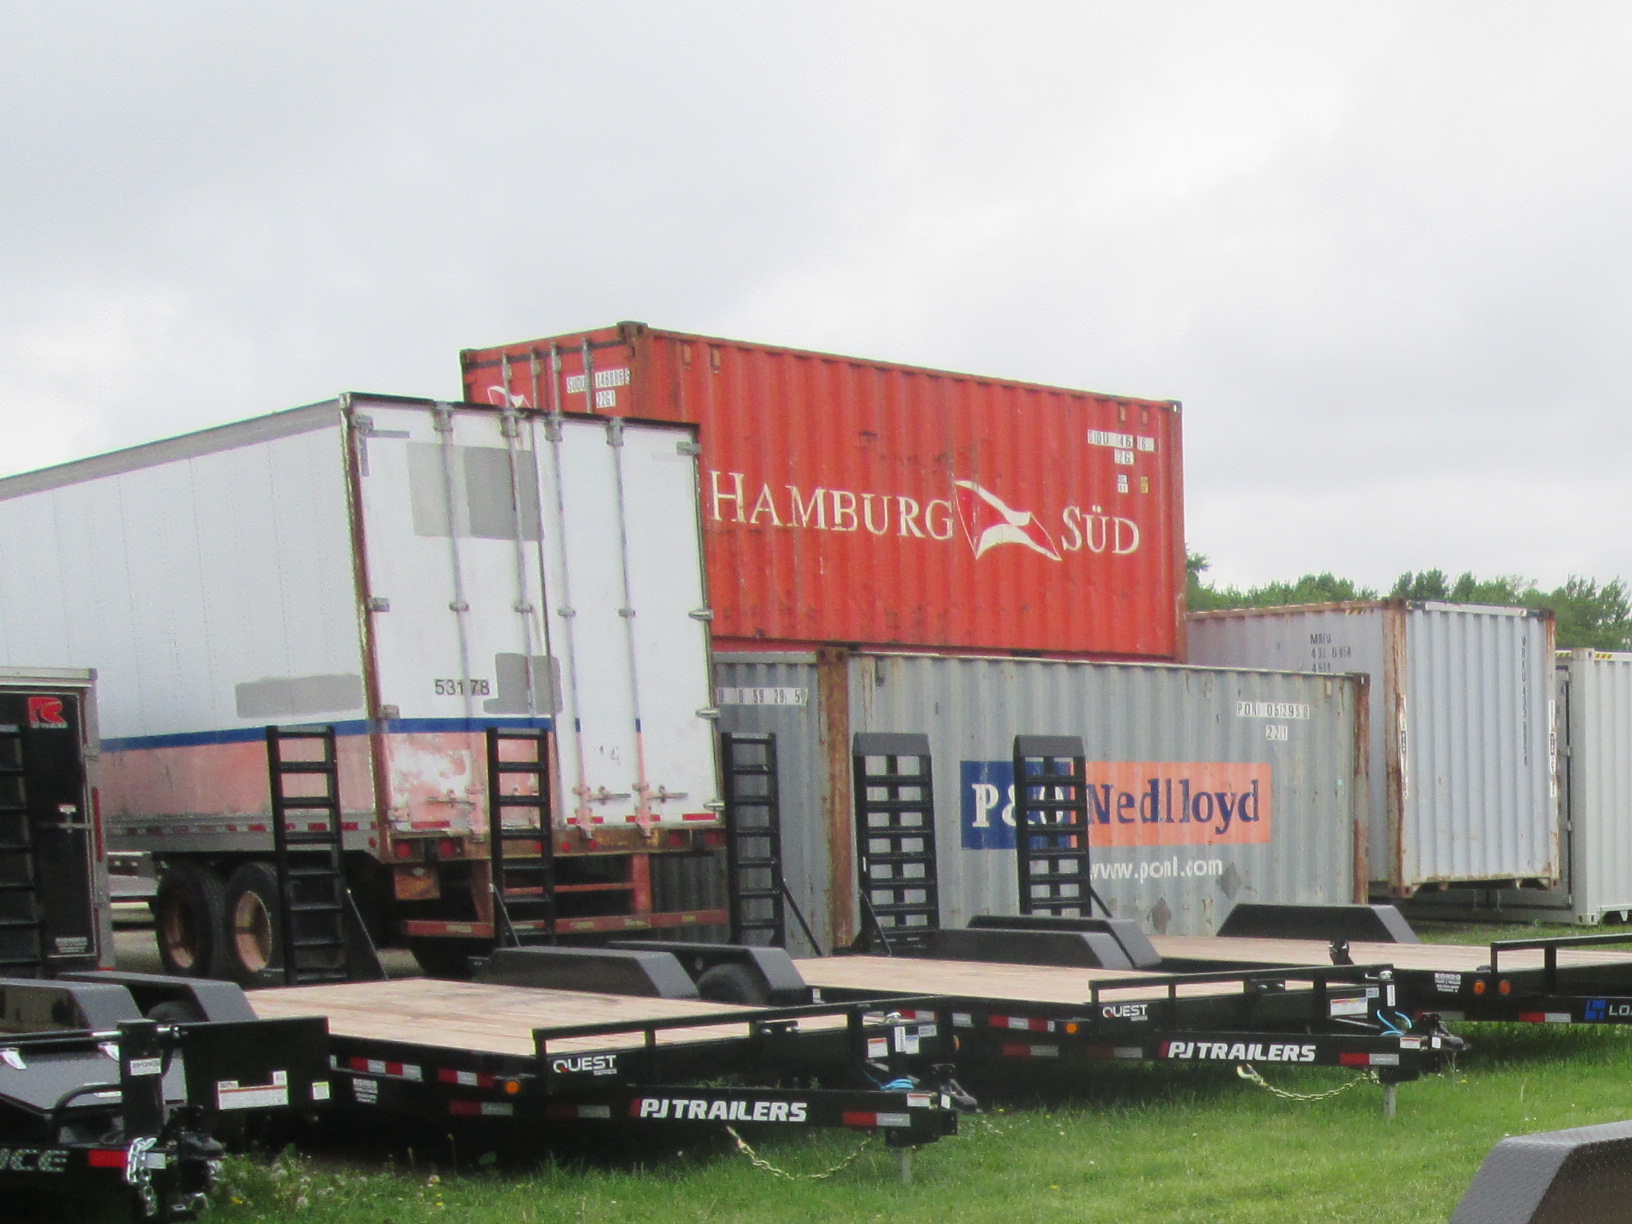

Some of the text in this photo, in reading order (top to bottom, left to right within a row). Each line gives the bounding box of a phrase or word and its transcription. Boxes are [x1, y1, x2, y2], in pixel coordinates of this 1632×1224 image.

[710, 471, 1140, 555] HAMBURG SÜD
[1085, 779, 1260, 835] Nedlloyd
[1102, 1004, 1148, 1018] QUEST
[1168, 1041, 1316, 1062] PJ TRAILERS
[553, 1055, 617, 1073] QUEST
[640, 1098, 808, 1122] PJ TRAILERS
